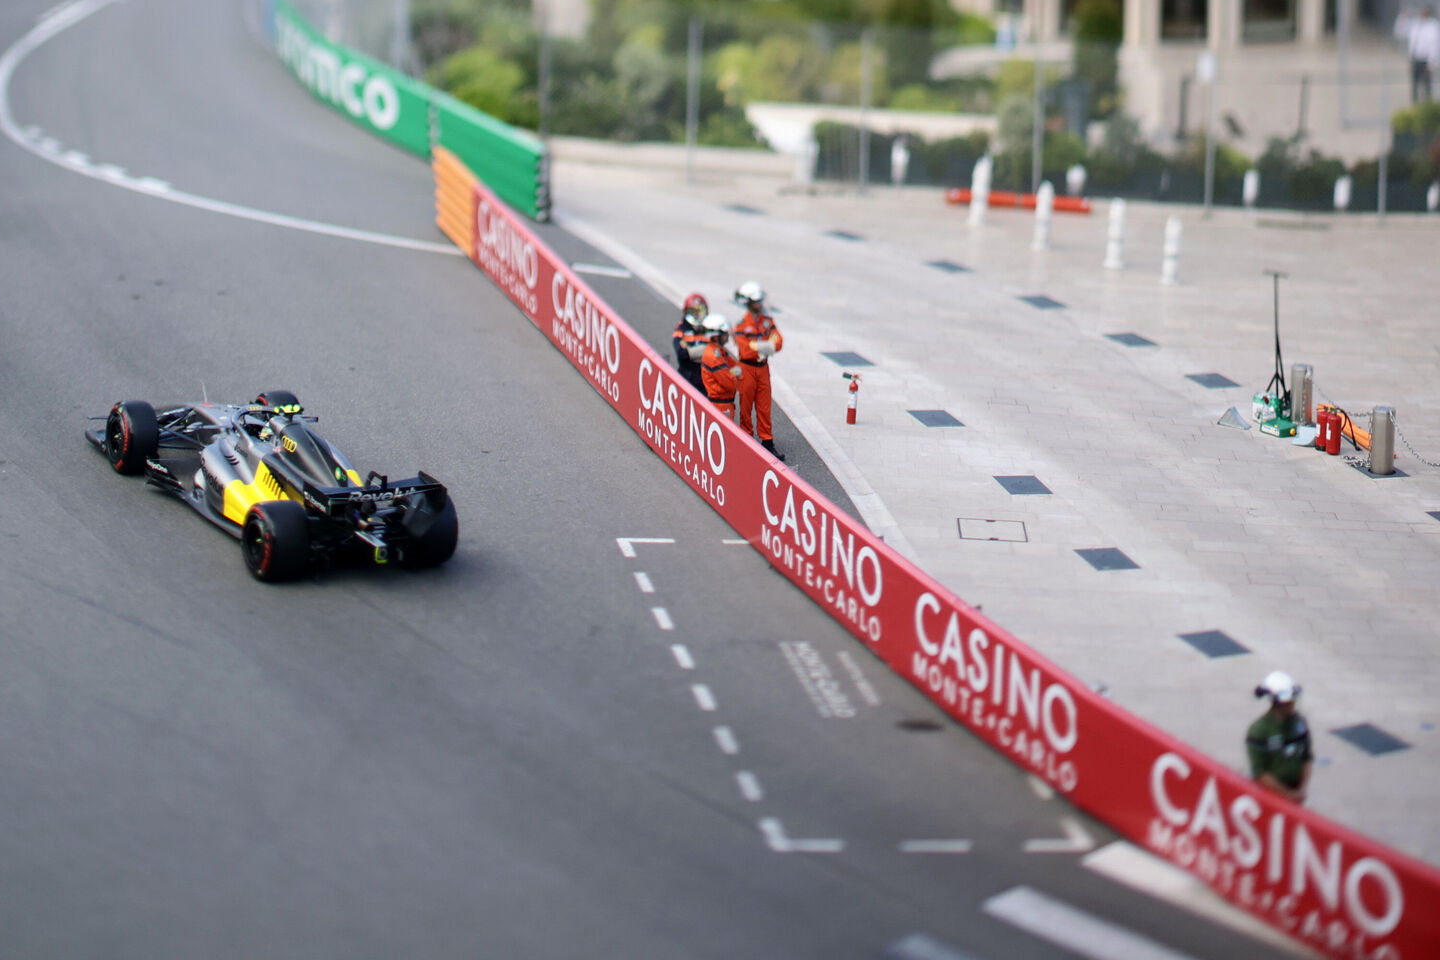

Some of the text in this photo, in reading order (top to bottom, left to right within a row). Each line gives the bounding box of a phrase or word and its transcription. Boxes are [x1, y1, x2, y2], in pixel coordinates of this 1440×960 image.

[478, 200, 538, 289] CASINO
[552, 271, 620, 374] CASINO
[638, 357, 726, 476] CASINO
[349, 486, 417, 503] Revolut
[761, 469, 883, 607] CASINO
[914, 592, 1078, 754] CASINO
[1150, 751, 1405, 938] CASINO
